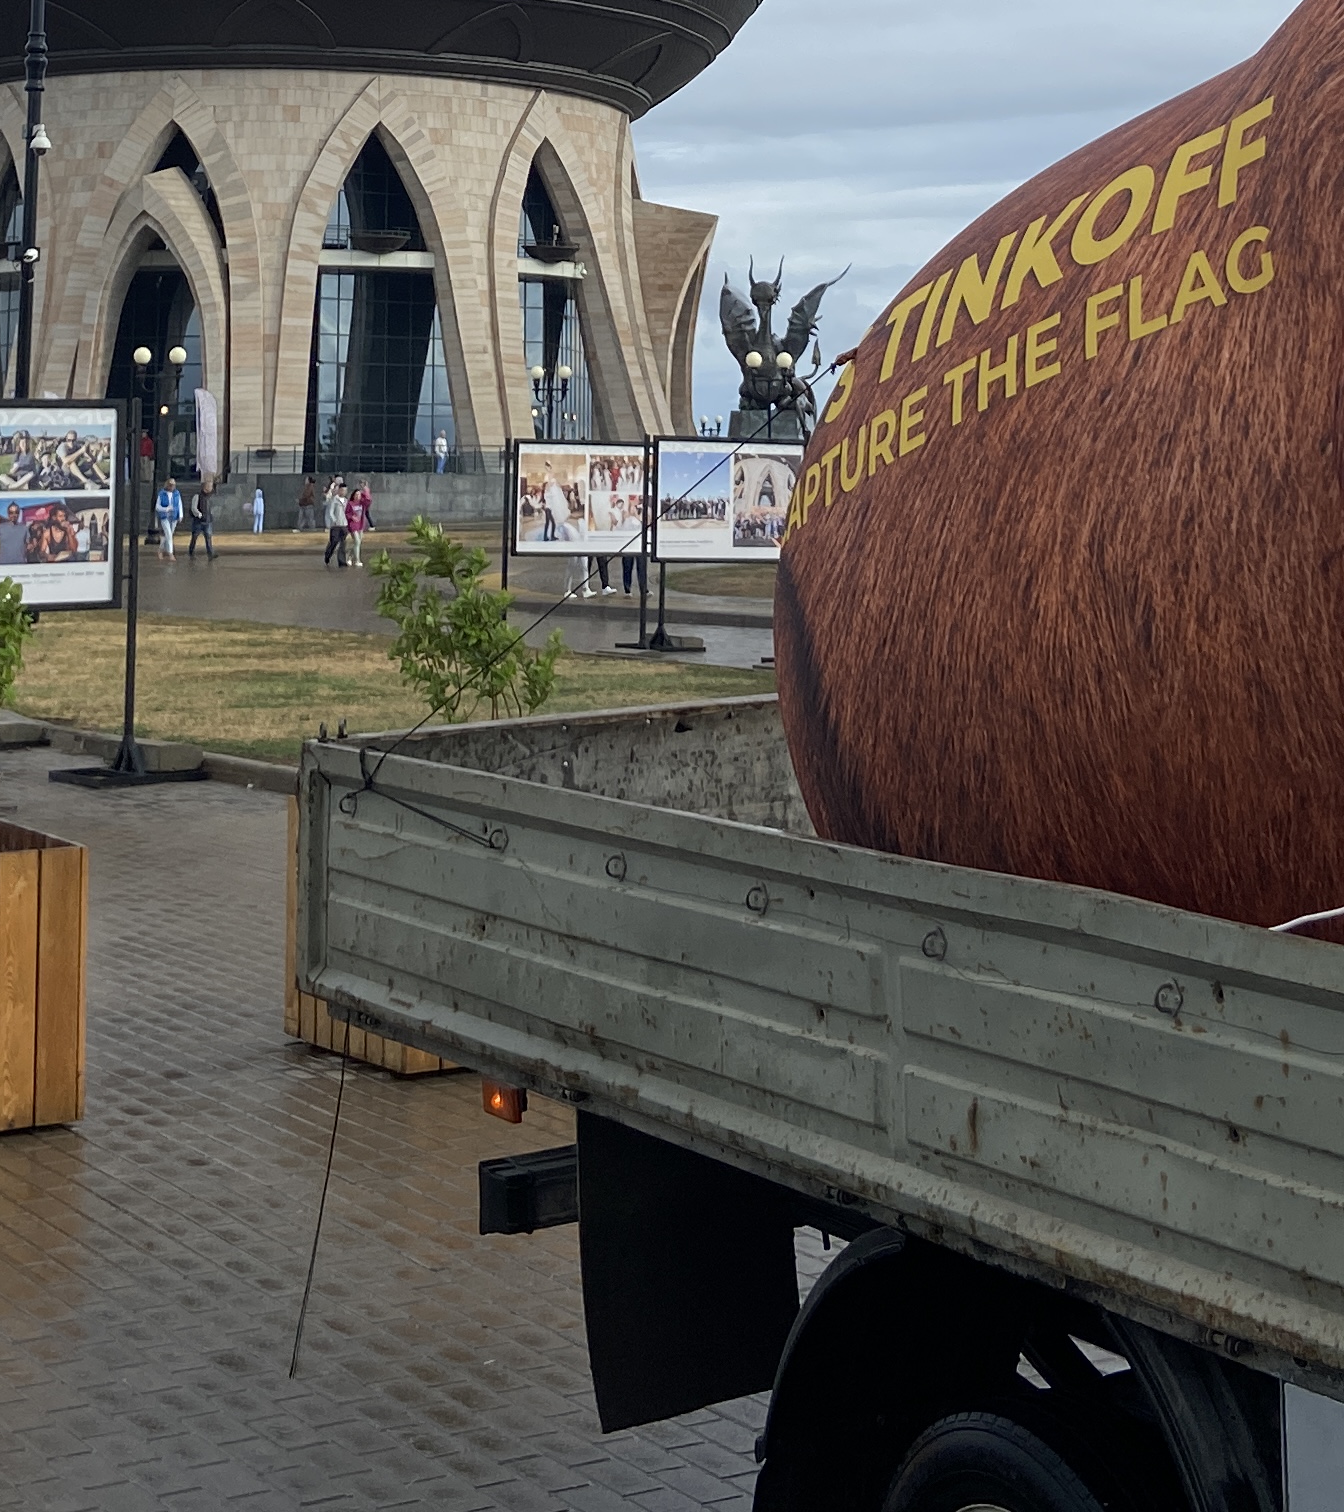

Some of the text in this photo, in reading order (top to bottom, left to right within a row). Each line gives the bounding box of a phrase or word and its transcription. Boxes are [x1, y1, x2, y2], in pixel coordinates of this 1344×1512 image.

[782, 385, 929, 542] APTURE
[942, 311, 1062, 427] THE
[1084, 226, 1276, 361] FLAG
[879, 95, 1275, 384] TINKOFF
